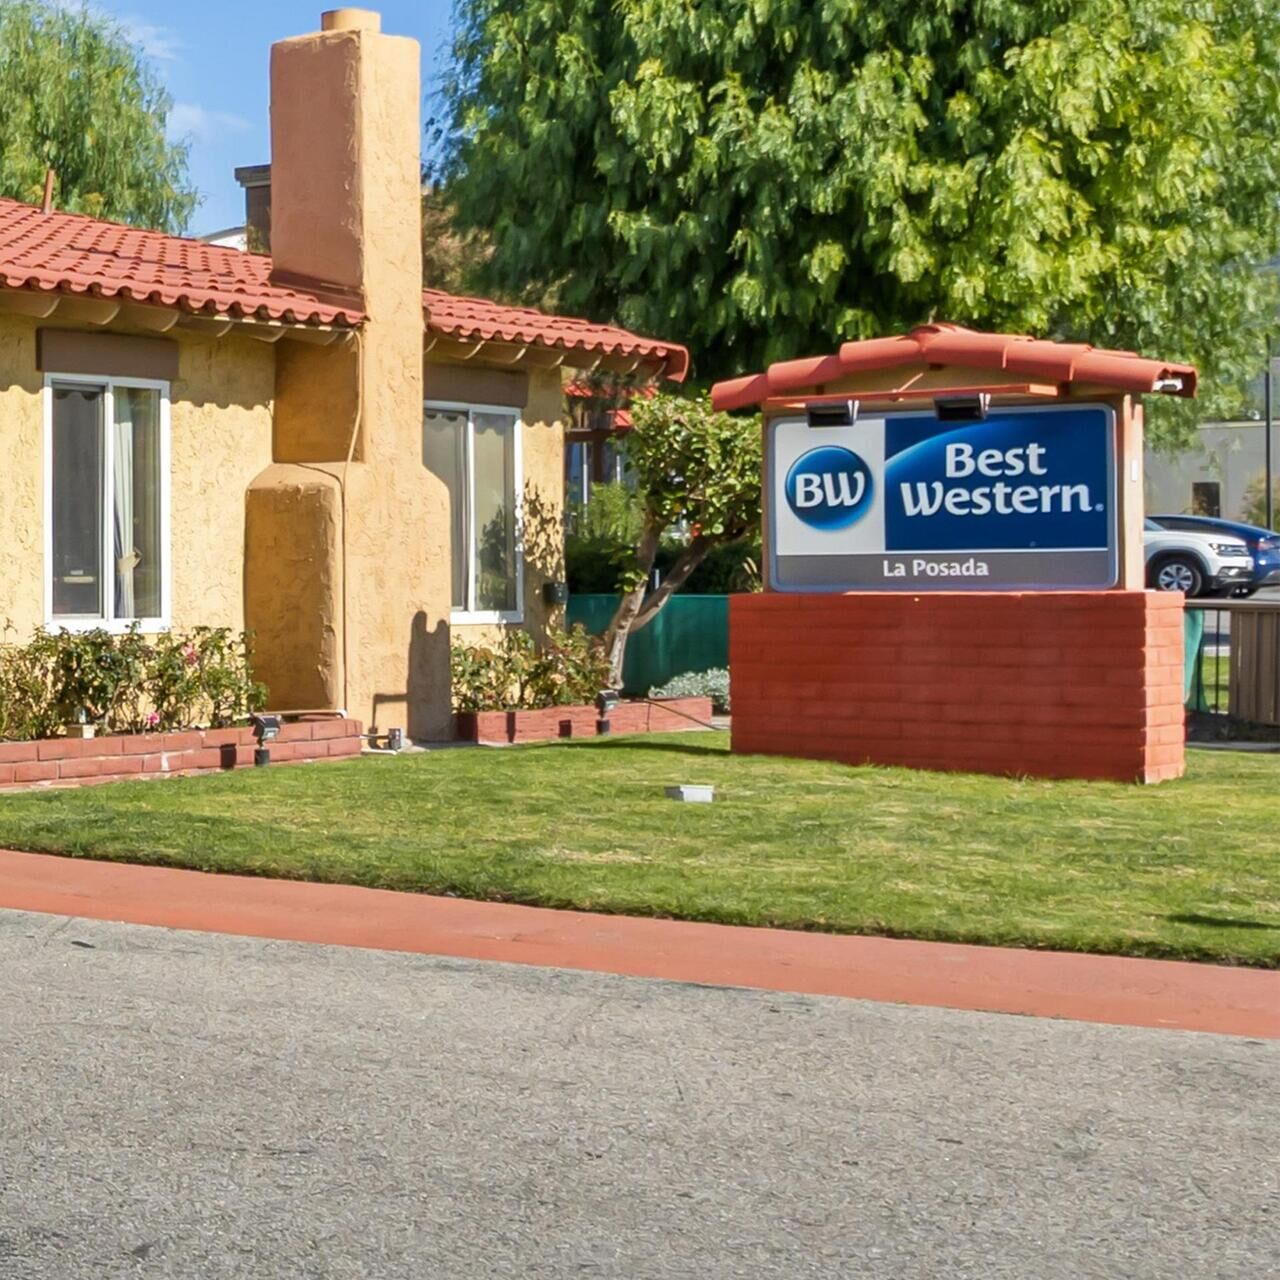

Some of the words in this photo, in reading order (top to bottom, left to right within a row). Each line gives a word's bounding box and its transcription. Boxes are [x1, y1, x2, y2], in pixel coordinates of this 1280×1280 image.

[945, 442, 1048, 478] Best
[795, 471, 865, 508] BW
[900, 481, 1093, 517] Western
[883, 559, 906, 577] La
[912, 558, 989, 577] Posada
